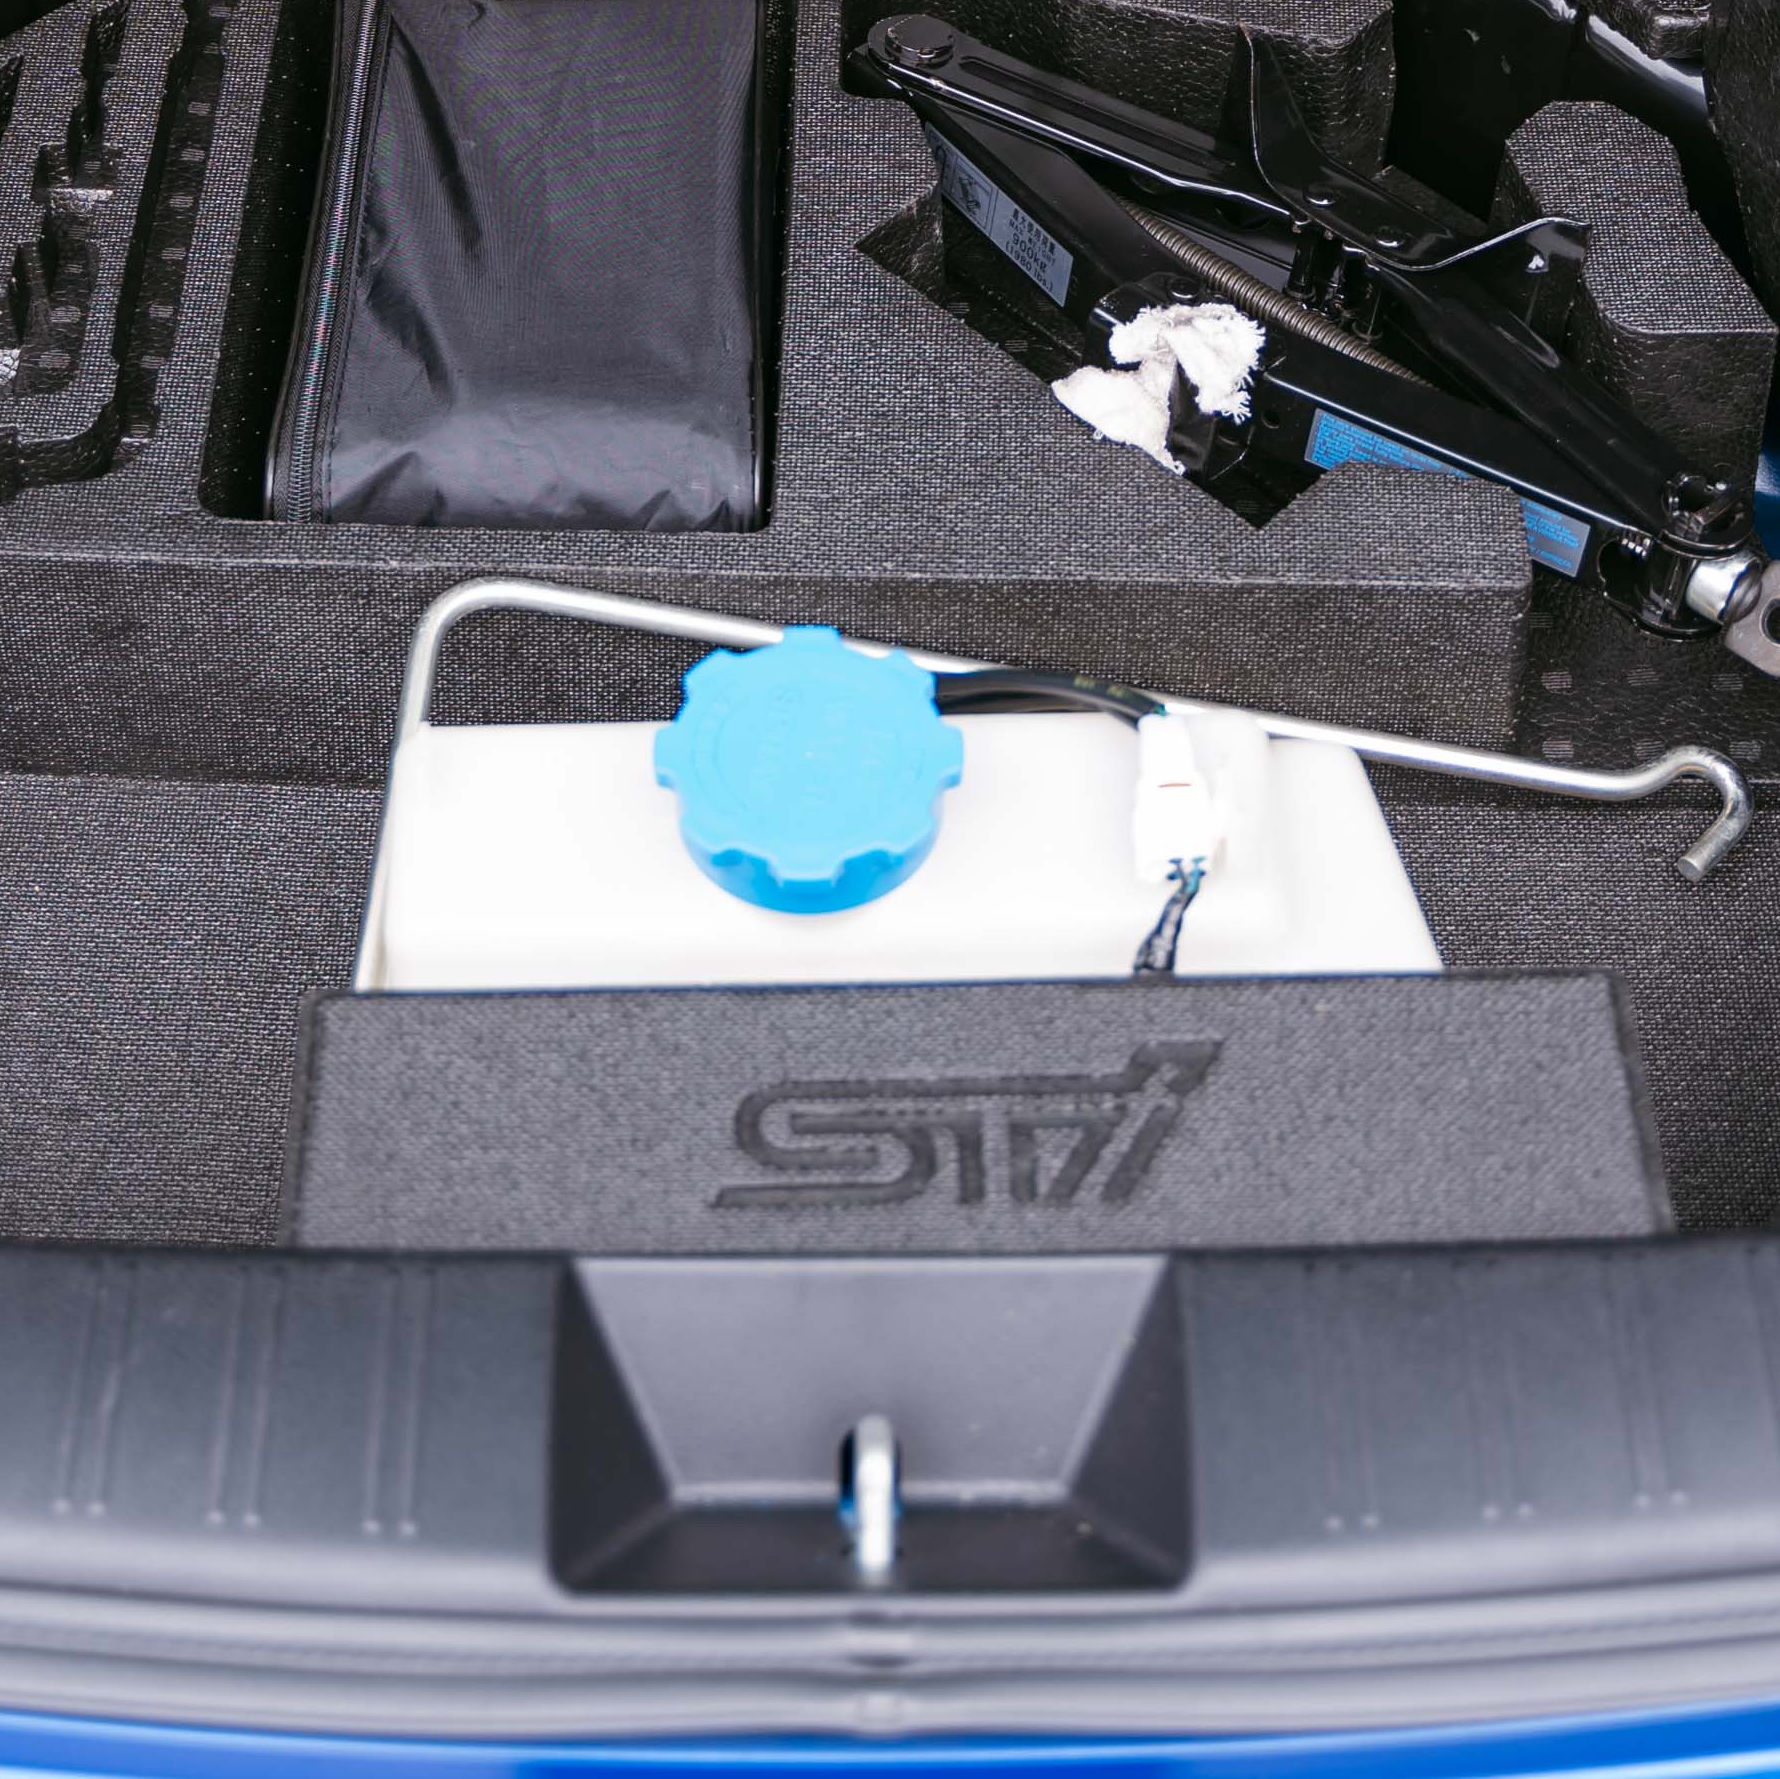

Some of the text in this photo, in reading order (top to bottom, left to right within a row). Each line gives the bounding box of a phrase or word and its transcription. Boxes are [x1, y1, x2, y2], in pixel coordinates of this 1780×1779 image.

[1005, 241, 1054, 293] (1980 lbs.)
[1012, 232, 1047, 274] 900kg
